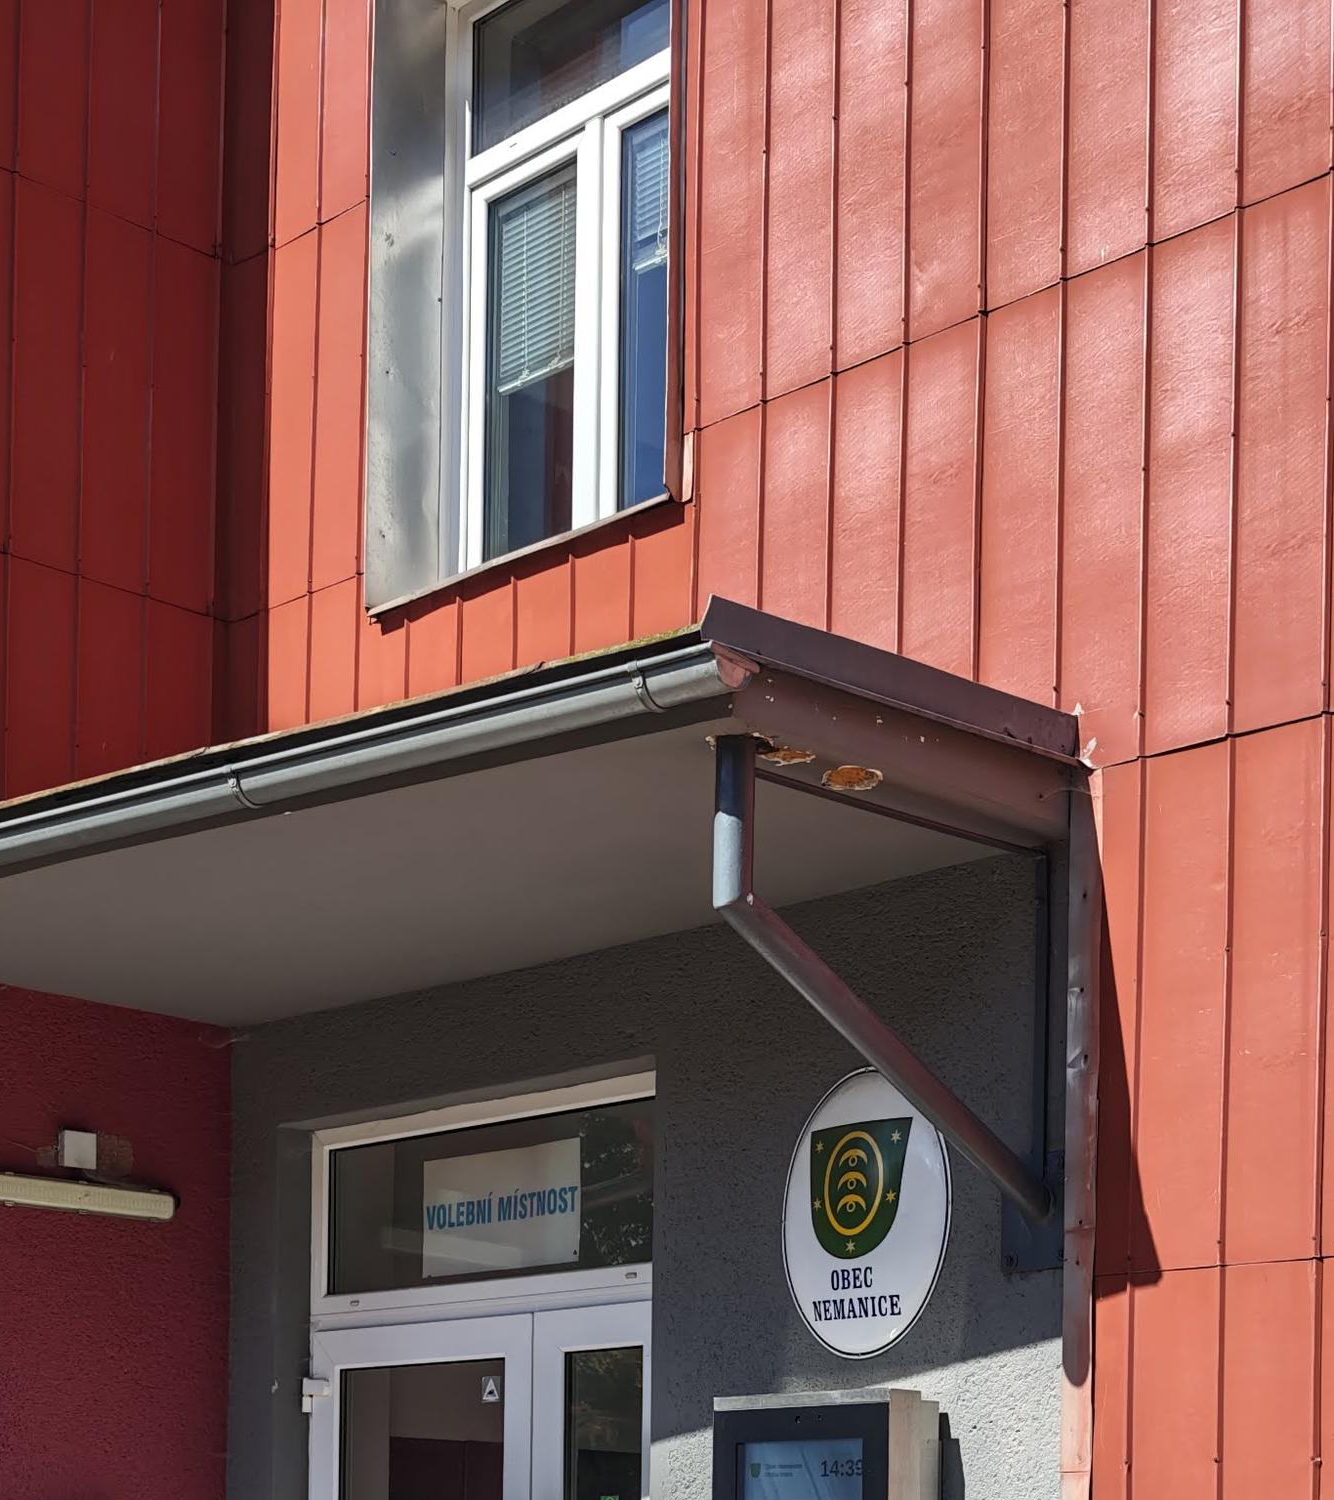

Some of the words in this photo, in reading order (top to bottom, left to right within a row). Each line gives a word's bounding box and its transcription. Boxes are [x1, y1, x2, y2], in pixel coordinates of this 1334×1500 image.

[426, 1191, 493, 1231] VOLEBNÍ
[497, 1185, 579, 1223] MÍSTNOST
[830, 1266, 874, 1291] OBEC
[812, 1294, 902, 1322] NEMANICE
